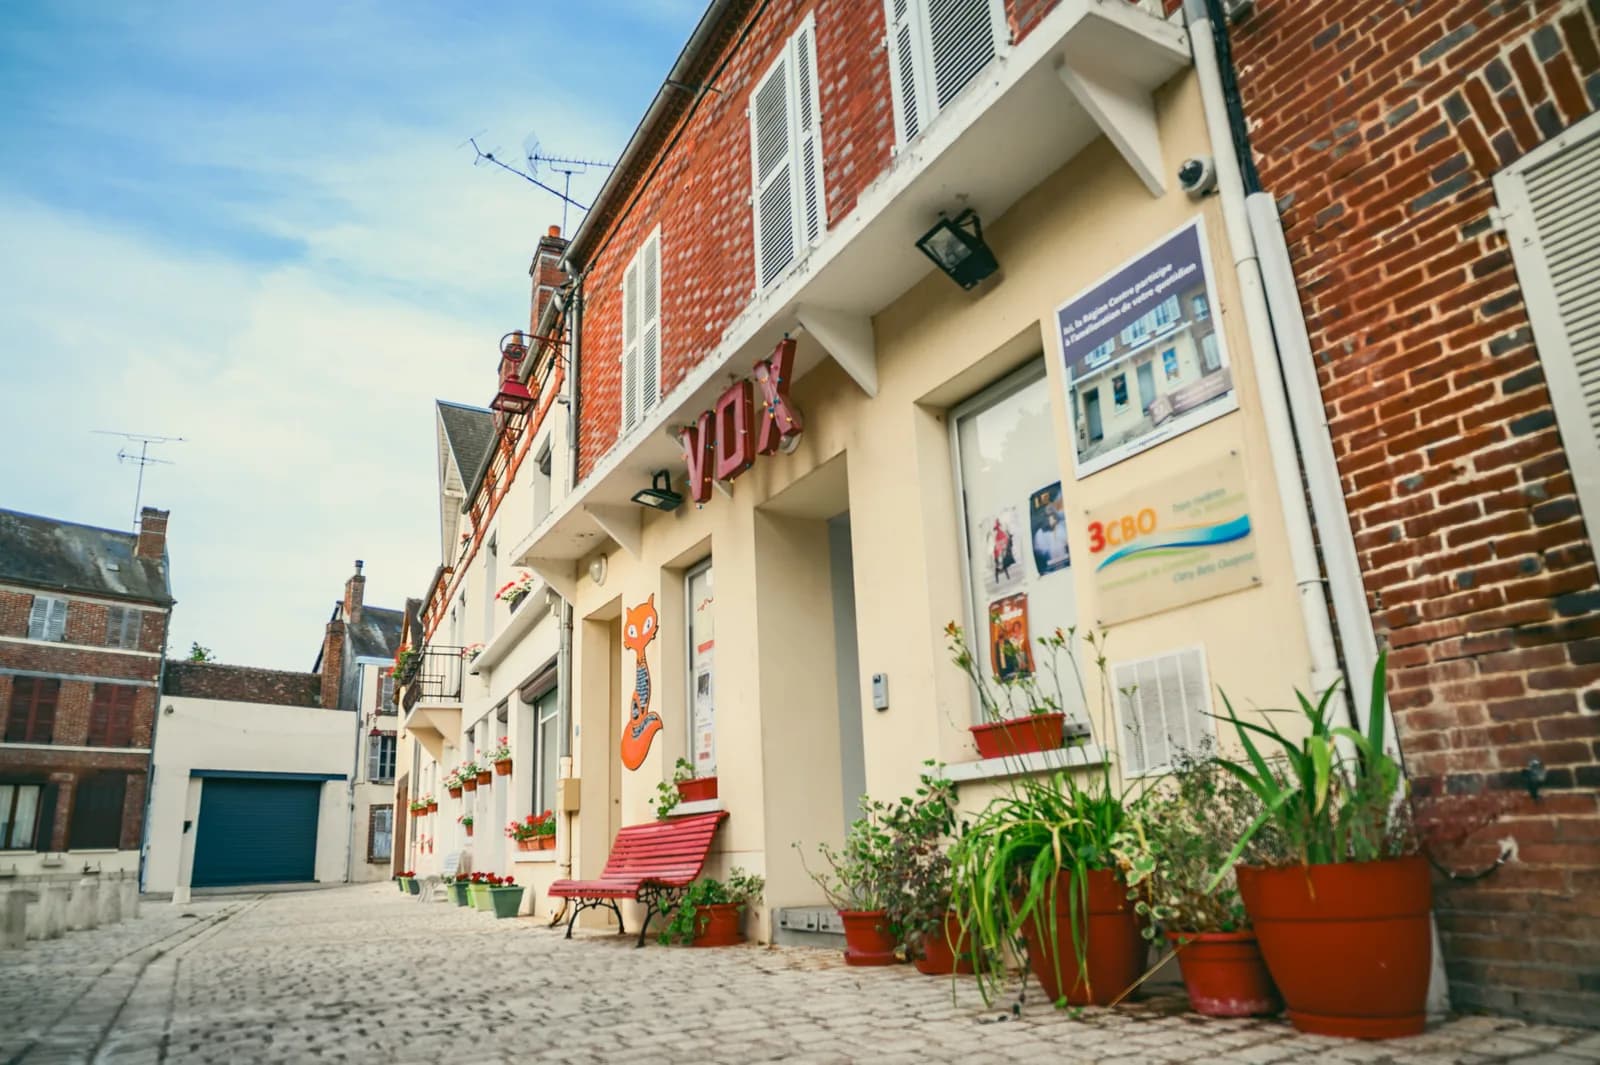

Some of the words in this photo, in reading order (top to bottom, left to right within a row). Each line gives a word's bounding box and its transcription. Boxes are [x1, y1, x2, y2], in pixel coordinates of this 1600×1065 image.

[1107, 287, 1135, 308] Centre
[1134, 263, 1173, 294] participe
[1120, 302, 1132, 313] de
[1131, 288, 1155, 306] votre
[1154, 263, 1197, 294] quotidien
[679, 338, 803, 504] VOX
[1087, 507, 1157, 554] 3CBO
